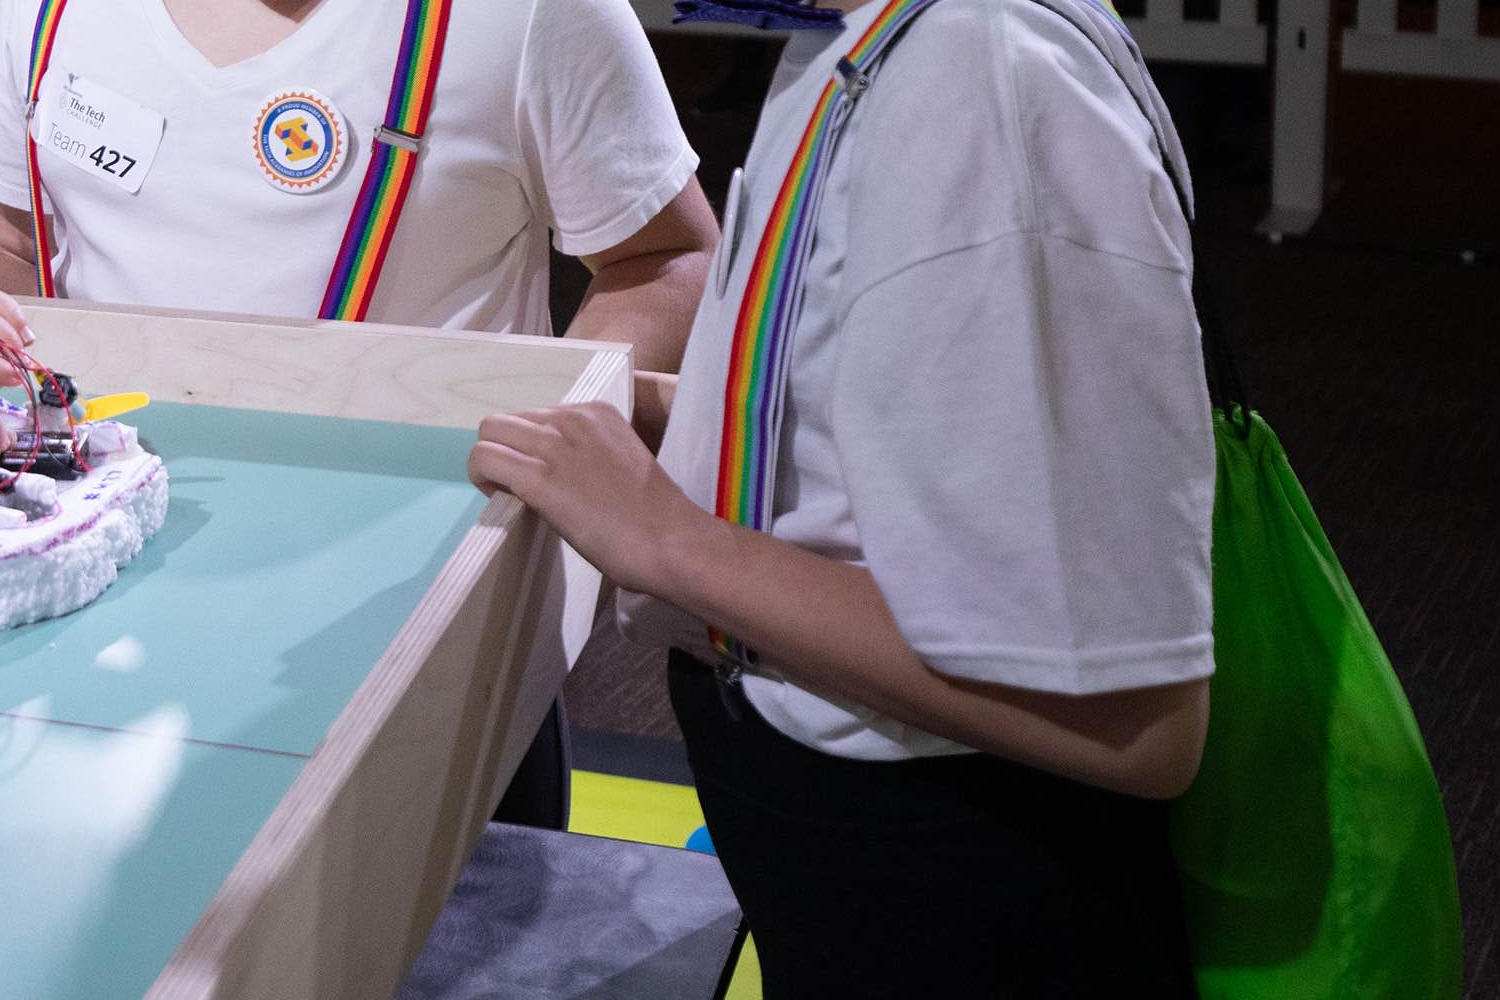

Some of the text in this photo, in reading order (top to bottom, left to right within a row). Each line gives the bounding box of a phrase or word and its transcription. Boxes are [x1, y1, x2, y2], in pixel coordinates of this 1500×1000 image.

[69, 97, 106, 122] The Tech
[49, 122, 137, 178] Team 427
